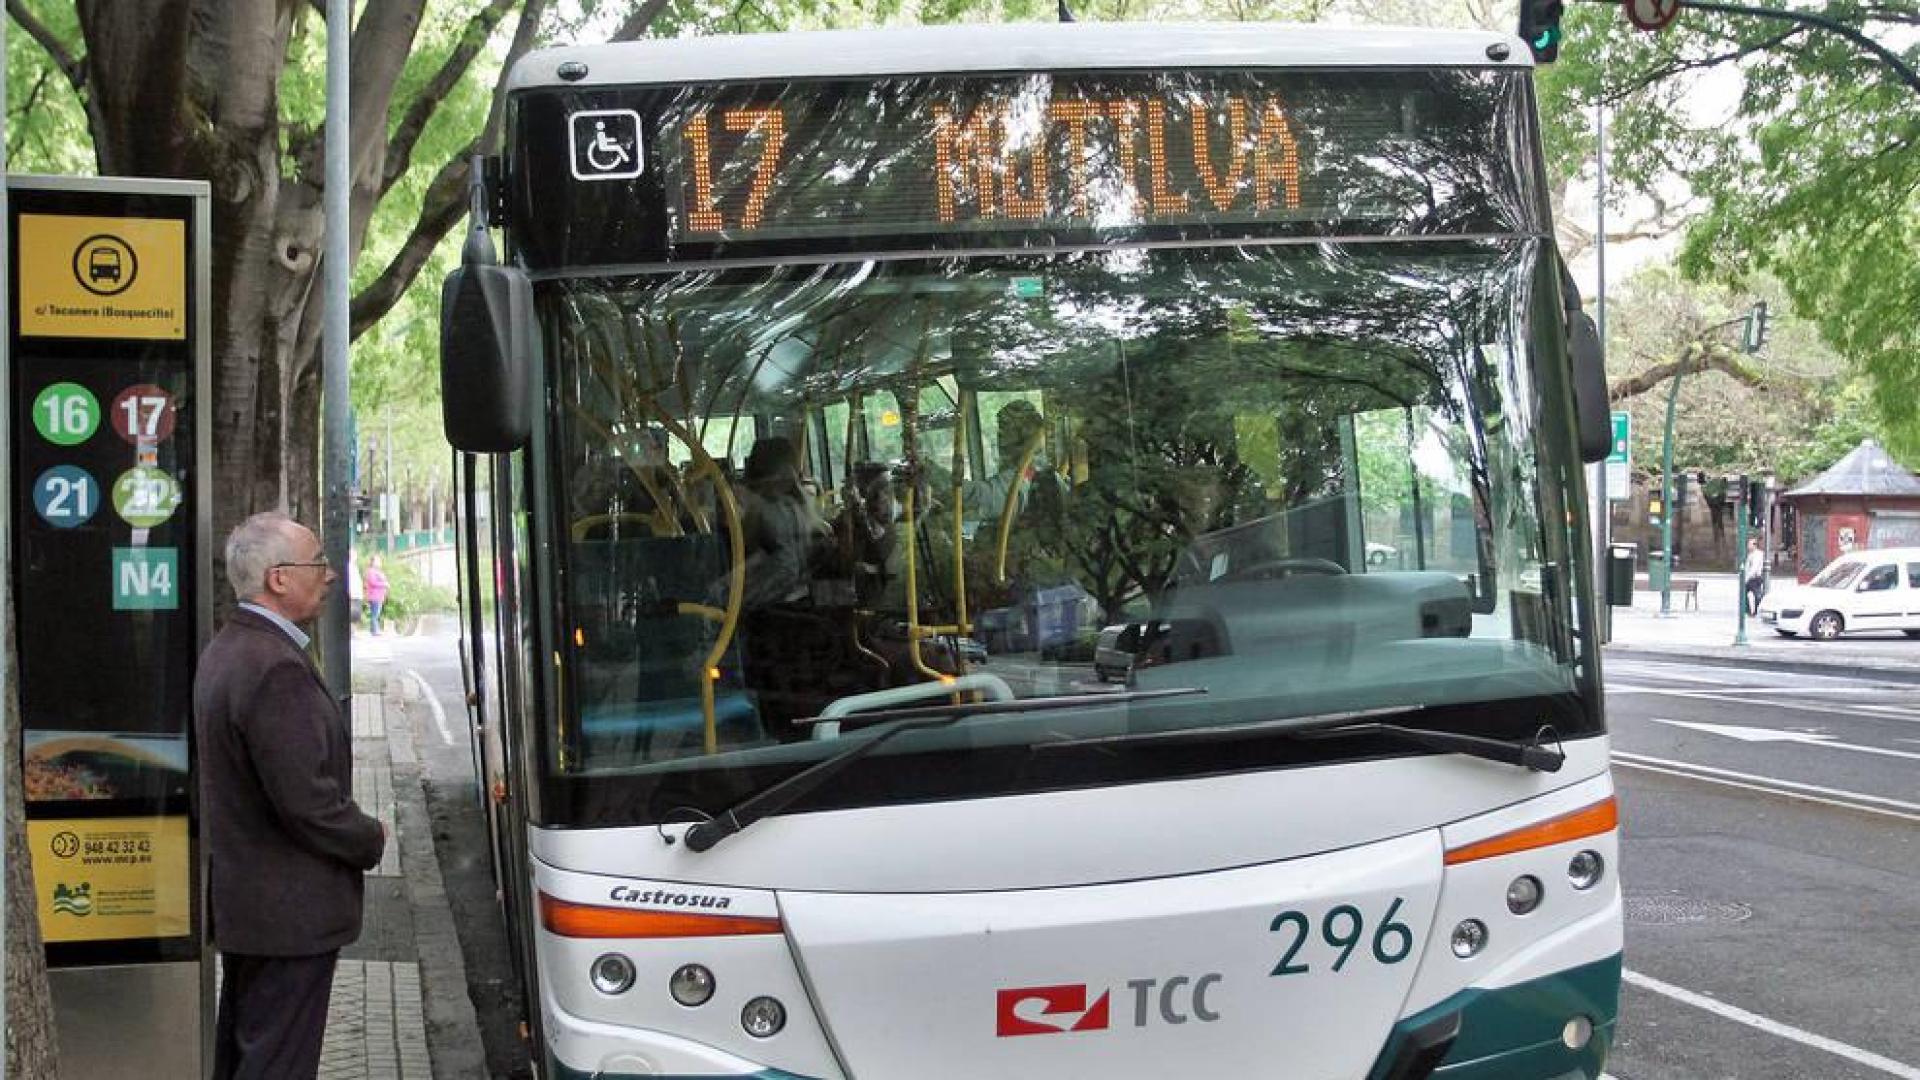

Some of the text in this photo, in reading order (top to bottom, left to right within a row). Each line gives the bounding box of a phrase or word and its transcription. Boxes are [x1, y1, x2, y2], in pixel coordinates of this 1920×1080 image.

[683, 95, 1300, 232] 17 MUTILVA
[42, 394, 90, 434] 16
[120, 396, 166, 436] 17
[45, 476, 89, 517] 21
[121, 477, 169, 517] 22
[119, 561, 171, 597] N4
[106, 840, 119, 854] 42
[137, 839, 151, 852] 42
[610, 885, 731, 910] Castrosua
[1269, 897, 1413, 977] 296
[1127, 973, 1223, 1027] TCC
